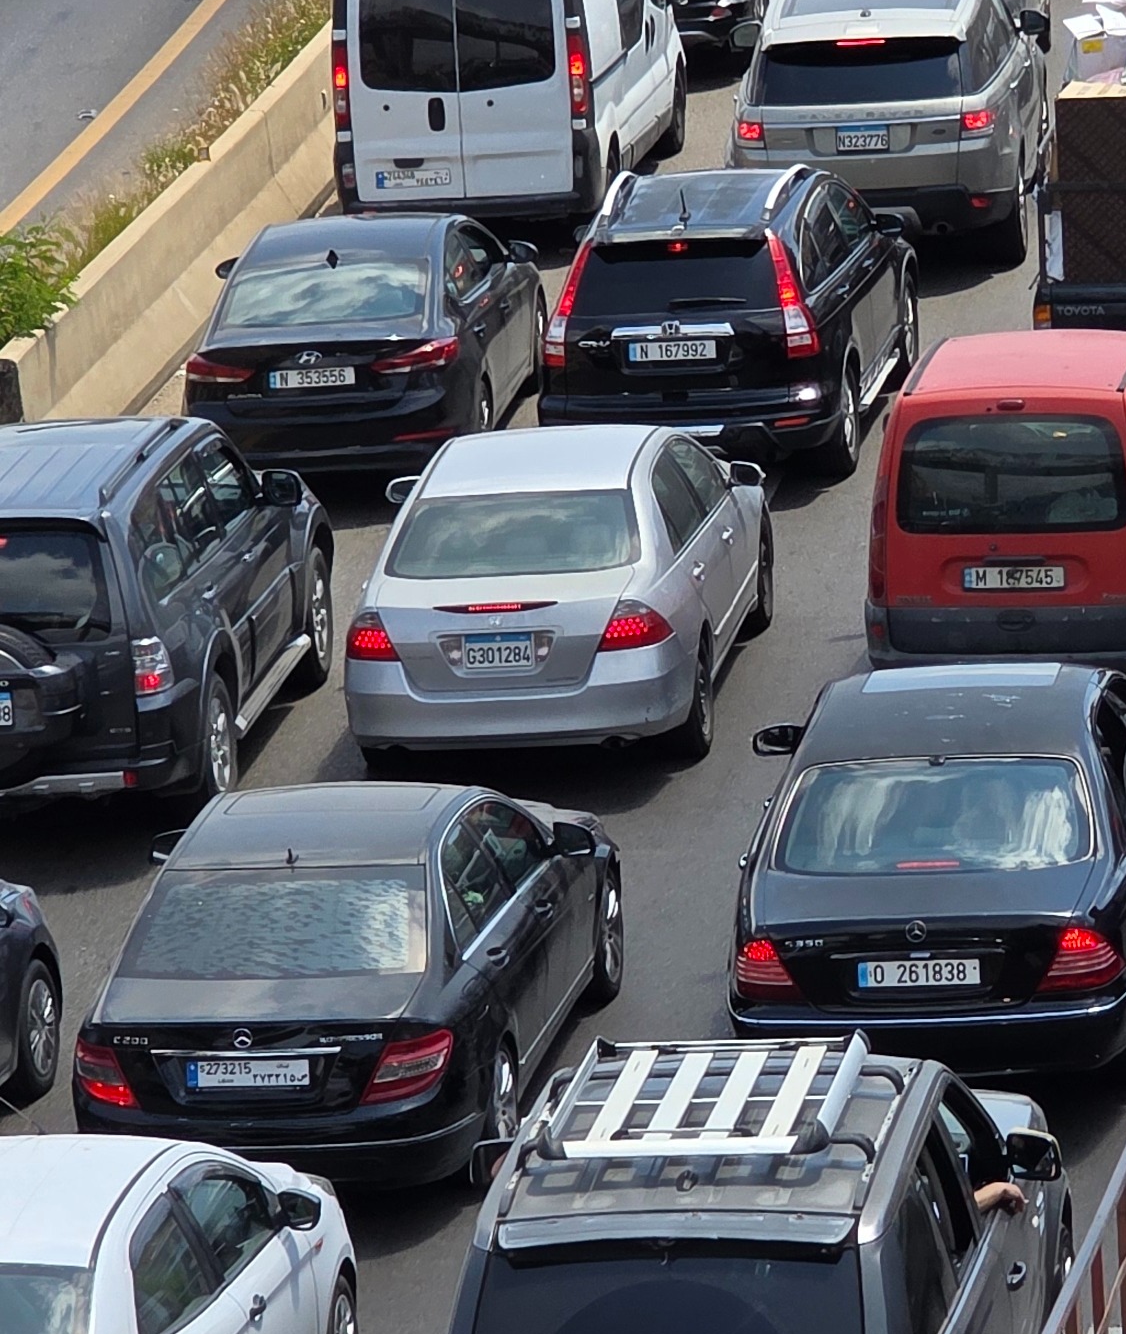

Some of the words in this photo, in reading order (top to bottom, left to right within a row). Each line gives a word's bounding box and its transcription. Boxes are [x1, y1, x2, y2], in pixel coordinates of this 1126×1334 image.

[838, 134, 888, 149] N323776
[1057, 306, 1106, 316] TOYOTA
[640, 344, 649, 360] N
[658, 342, 708, 359] 167992
[279, 372, 288, 386] N
[297, 368, 346, 385] 353556
[975, 569, 987, 586] M
[466, 646, 531, 664] G301284
[896, 962, 967, 984] 261838
